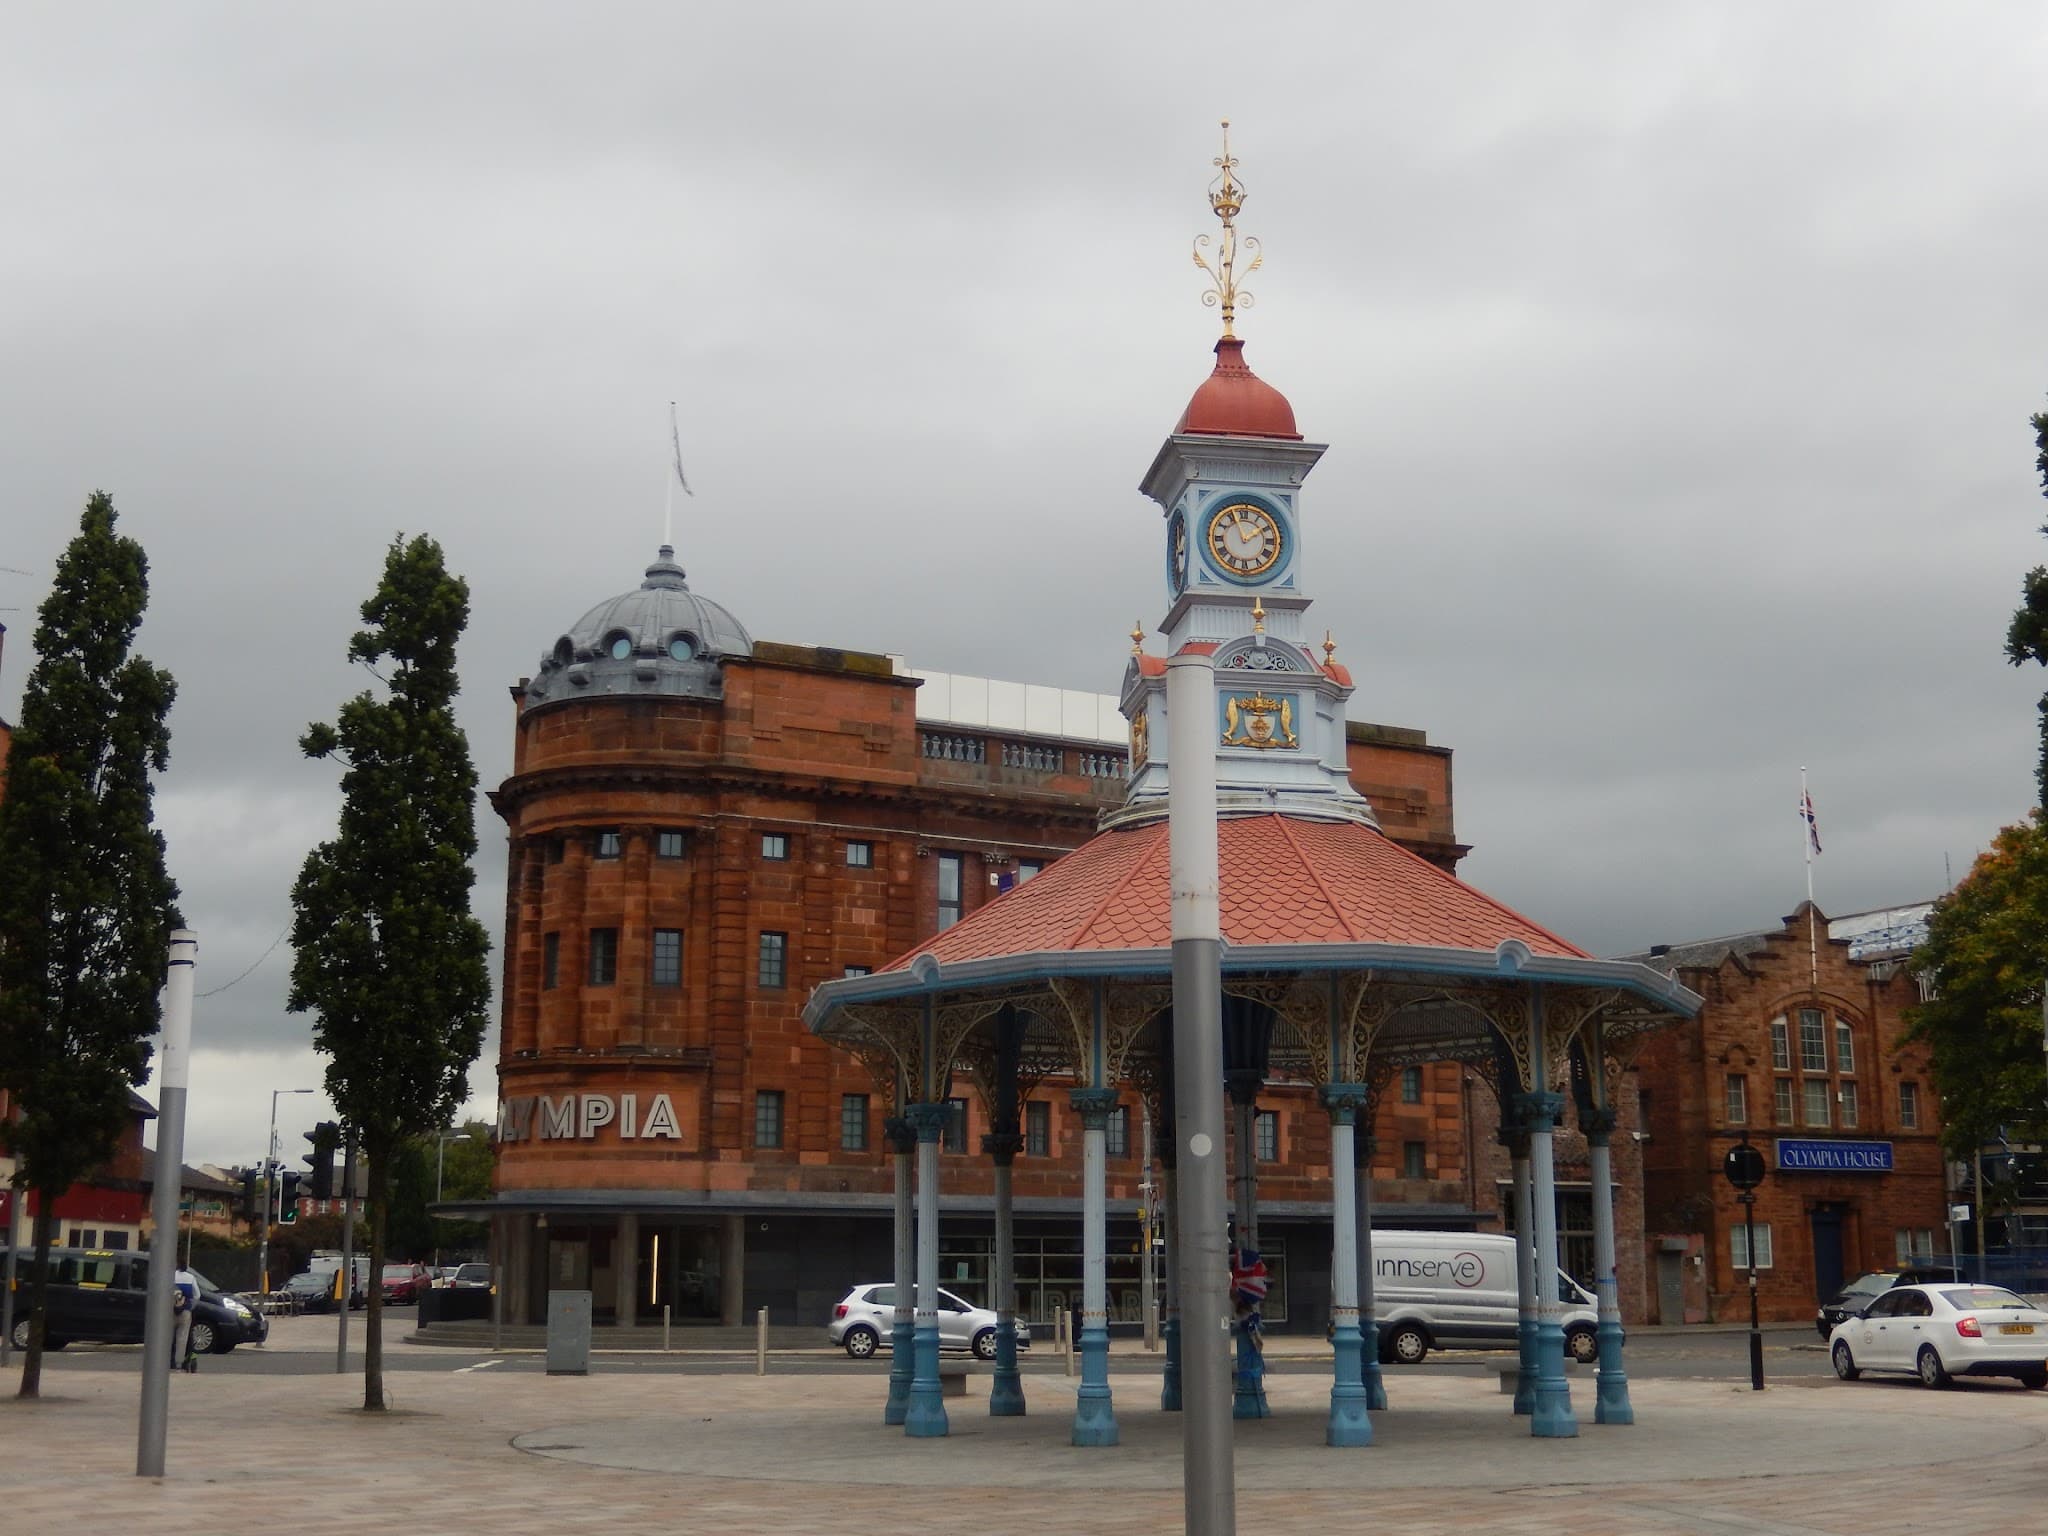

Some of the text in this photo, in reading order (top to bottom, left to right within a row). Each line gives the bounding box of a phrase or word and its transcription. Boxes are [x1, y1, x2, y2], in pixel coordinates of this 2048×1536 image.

[498, 1093, 682, 1142] LYMPIA
[1784, 1149, 1889, 1168] OLYMPIA HOUSE
[1376, 1258, 1475, 1278] innserve
[1013, 1288, 1169, 1322] LIBAR
